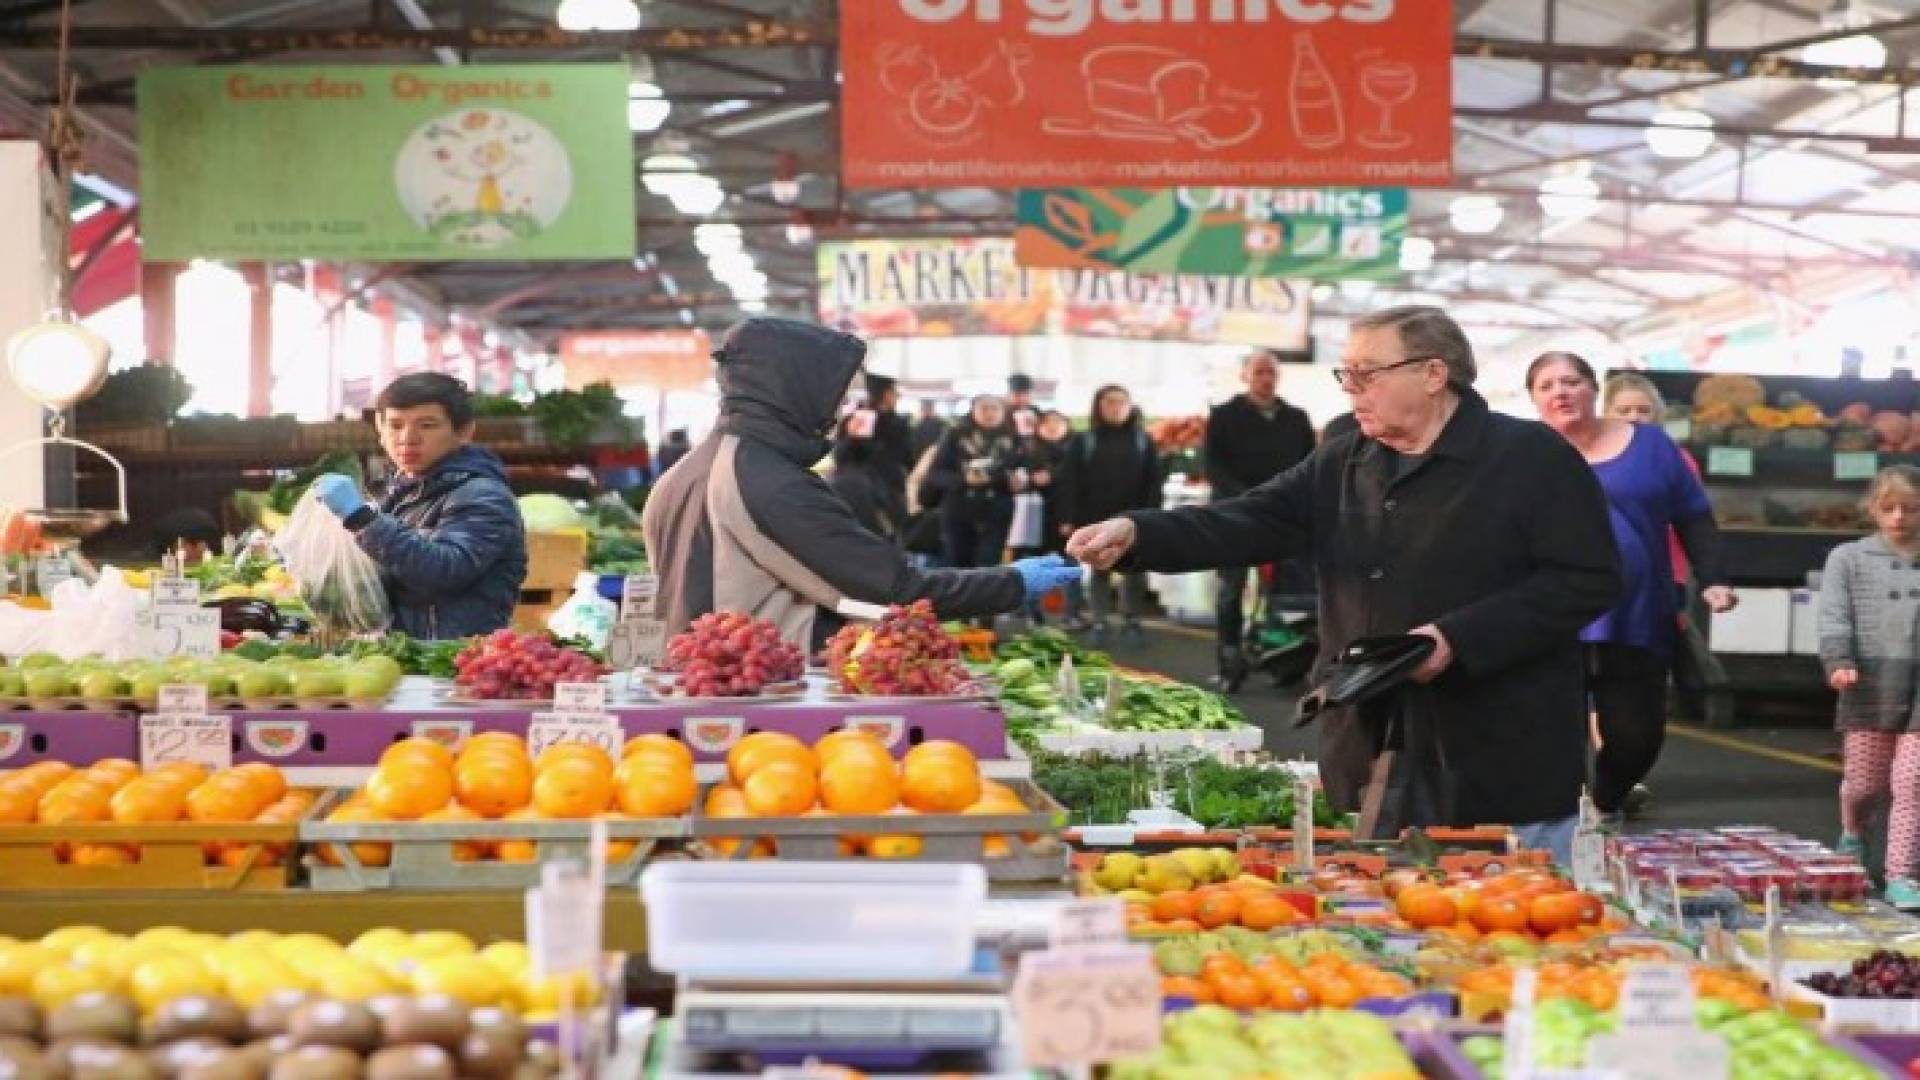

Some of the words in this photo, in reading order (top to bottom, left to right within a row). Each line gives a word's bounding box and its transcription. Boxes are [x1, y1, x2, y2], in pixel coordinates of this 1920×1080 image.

[227, 74, 366, 99] Garden
[391, 73, 554, 104] Organics
[1177, 186, 1384, 218] Organics
[835, 248, 1031, 300] MARKET
[572, 332, 696, 356] organics
